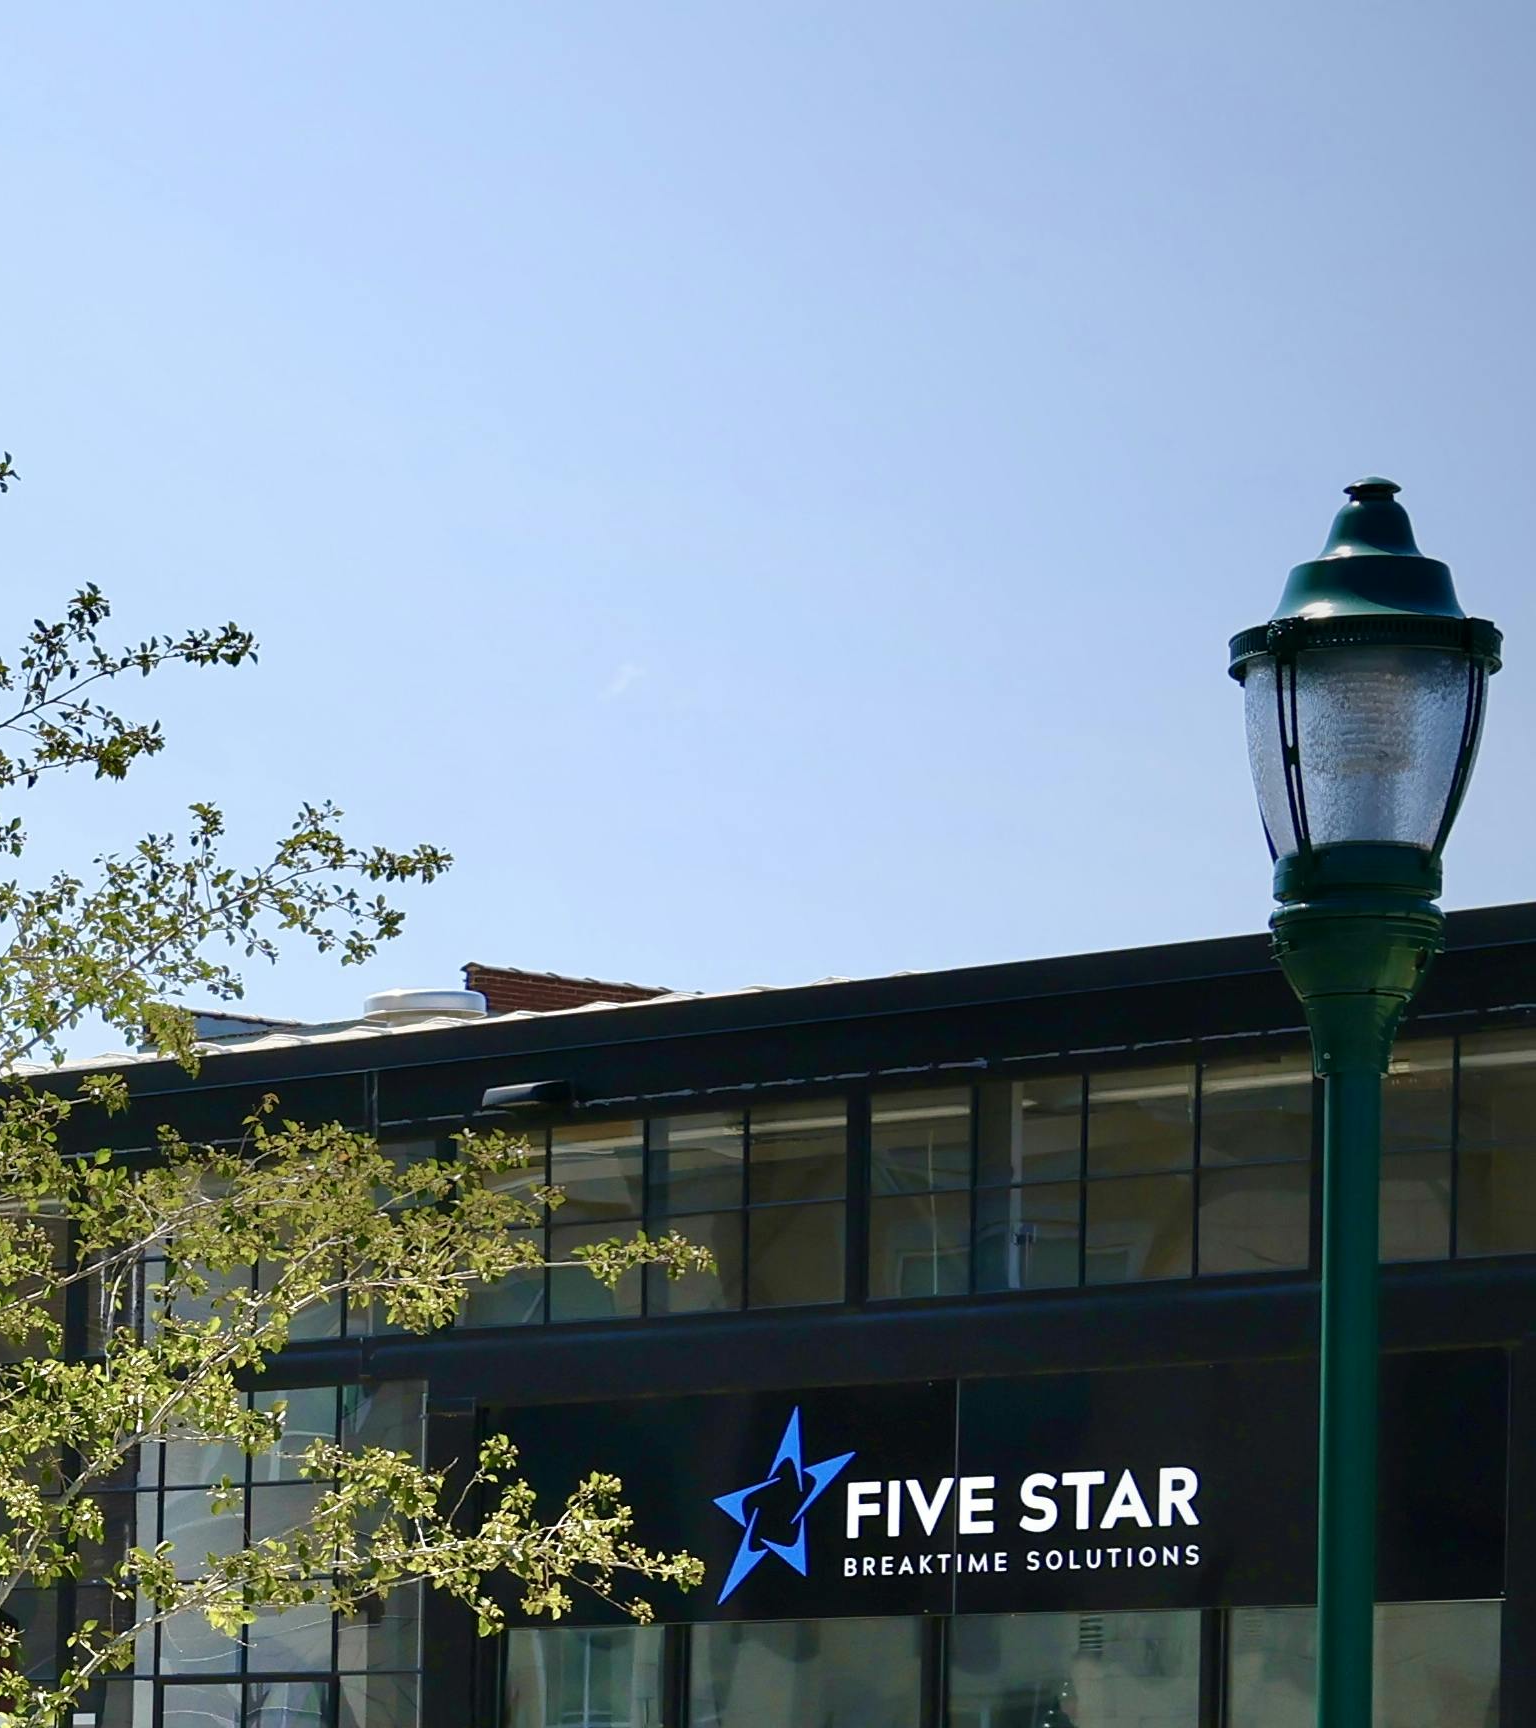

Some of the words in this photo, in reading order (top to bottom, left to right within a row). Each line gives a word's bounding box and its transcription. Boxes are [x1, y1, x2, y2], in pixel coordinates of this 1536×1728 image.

[846, 1475, 995, 1539] FIVE
[1019, 1466, 1200, 1533] STAR
[843, 1551, 1008, 1577] BREAKTIME
[1026, 1544, 1200, 1571] SOLUTIONS
